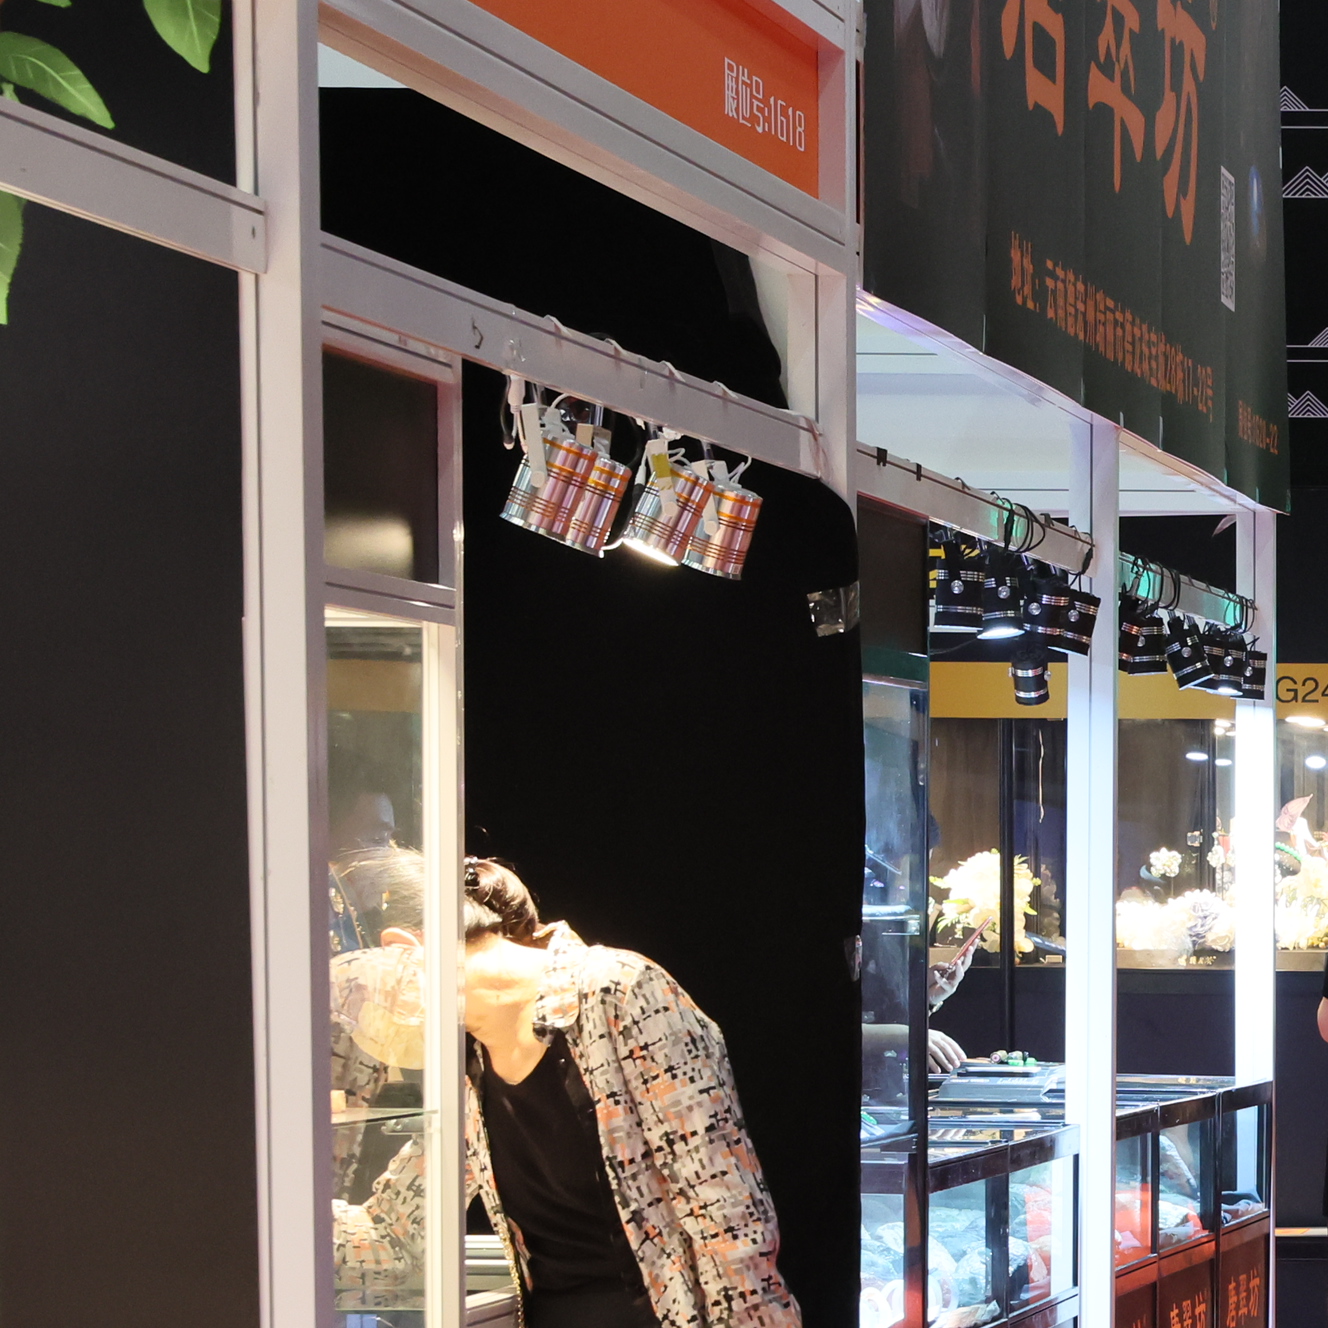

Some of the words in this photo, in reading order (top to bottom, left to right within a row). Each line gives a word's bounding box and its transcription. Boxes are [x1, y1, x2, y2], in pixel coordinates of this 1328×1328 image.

[724, 57, 806, 151] 展位号:1618
[1226, 1267, 1260, 1328] 唐翠坊
